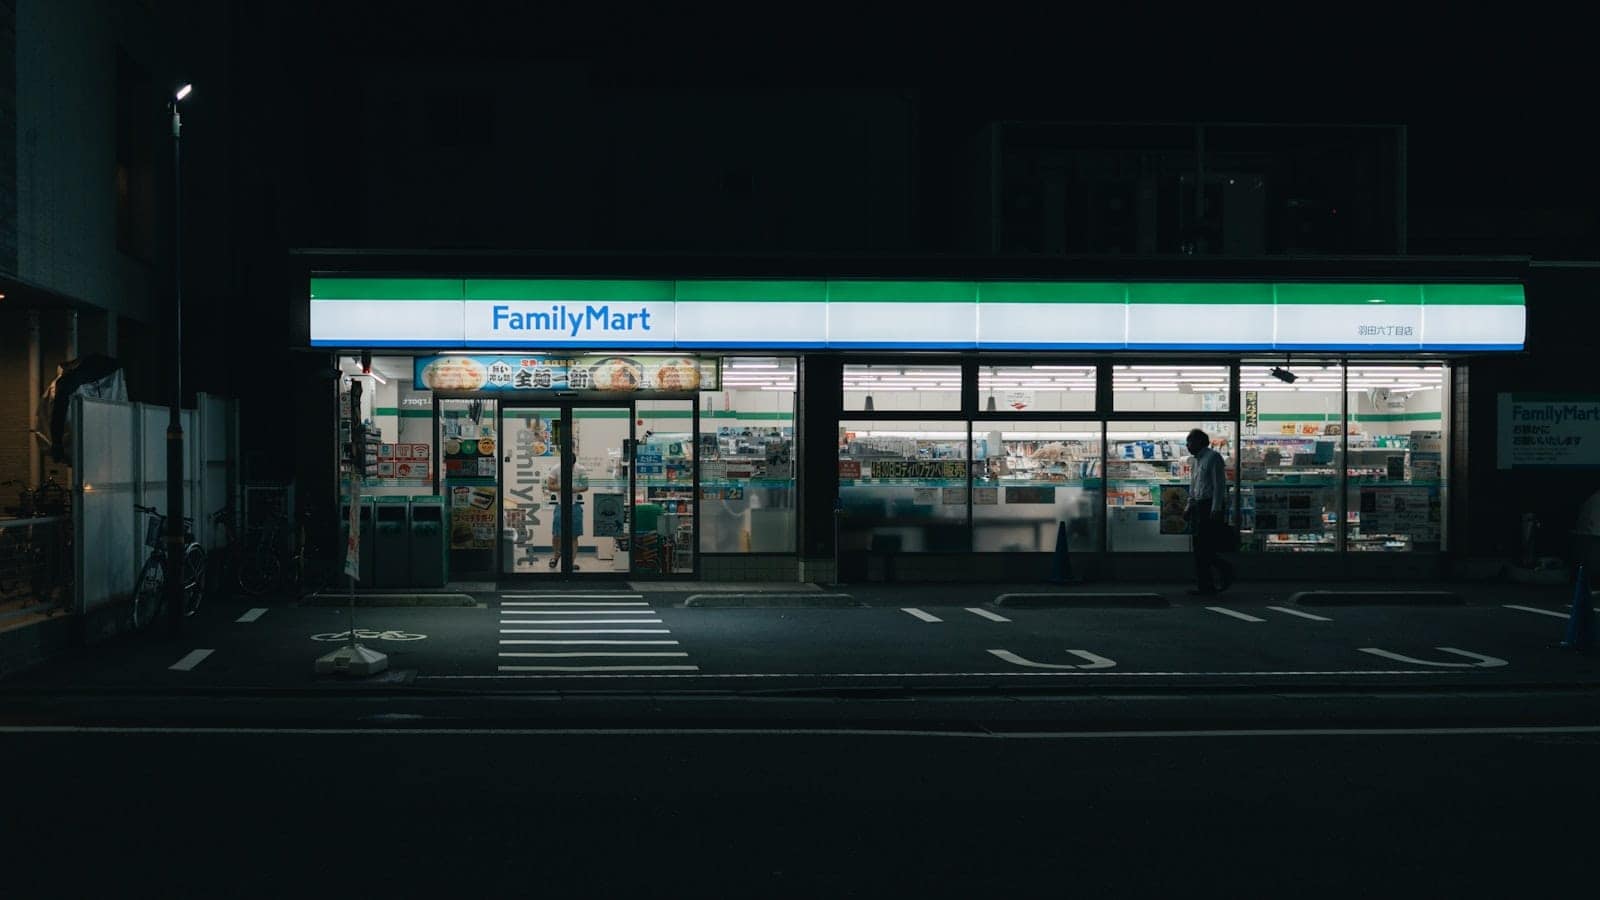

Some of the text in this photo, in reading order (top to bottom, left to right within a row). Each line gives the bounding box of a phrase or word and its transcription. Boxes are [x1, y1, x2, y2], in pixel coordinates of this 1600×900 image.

[493, 305, 651, 337] FamilyMart
[1359, 325, 1413, 336] 羽田六丁目店
[1513, 406, 1600, 424] FamilyMart
[510, 414, 540, 566] FamilyMart
